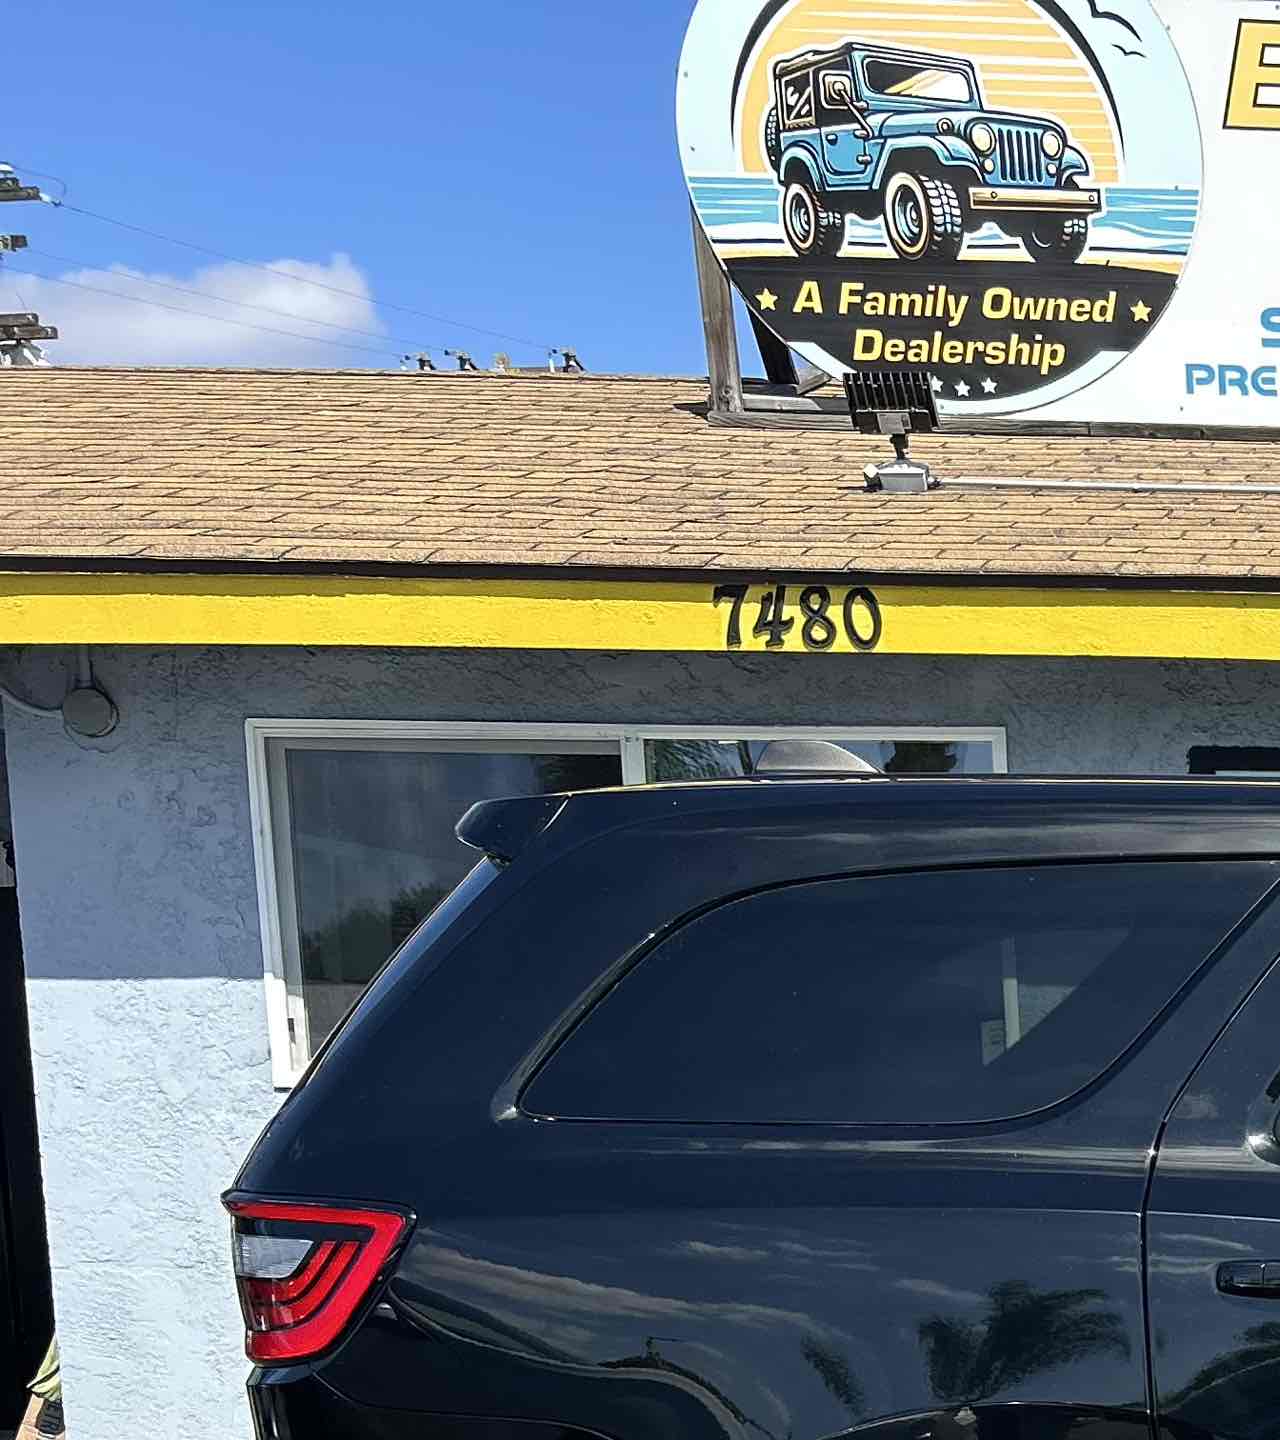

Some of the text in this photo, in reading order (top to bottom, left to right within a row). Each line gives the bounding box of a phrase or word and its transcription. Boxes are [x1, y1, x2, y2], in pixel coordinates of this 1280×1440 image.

[792, 281, 1117, 327] A Family Owned
[852, 328, 1065, 374] Dealership
[1184, 363, 1277, 396] PRE
[713, 584, 882, 650] 7480
